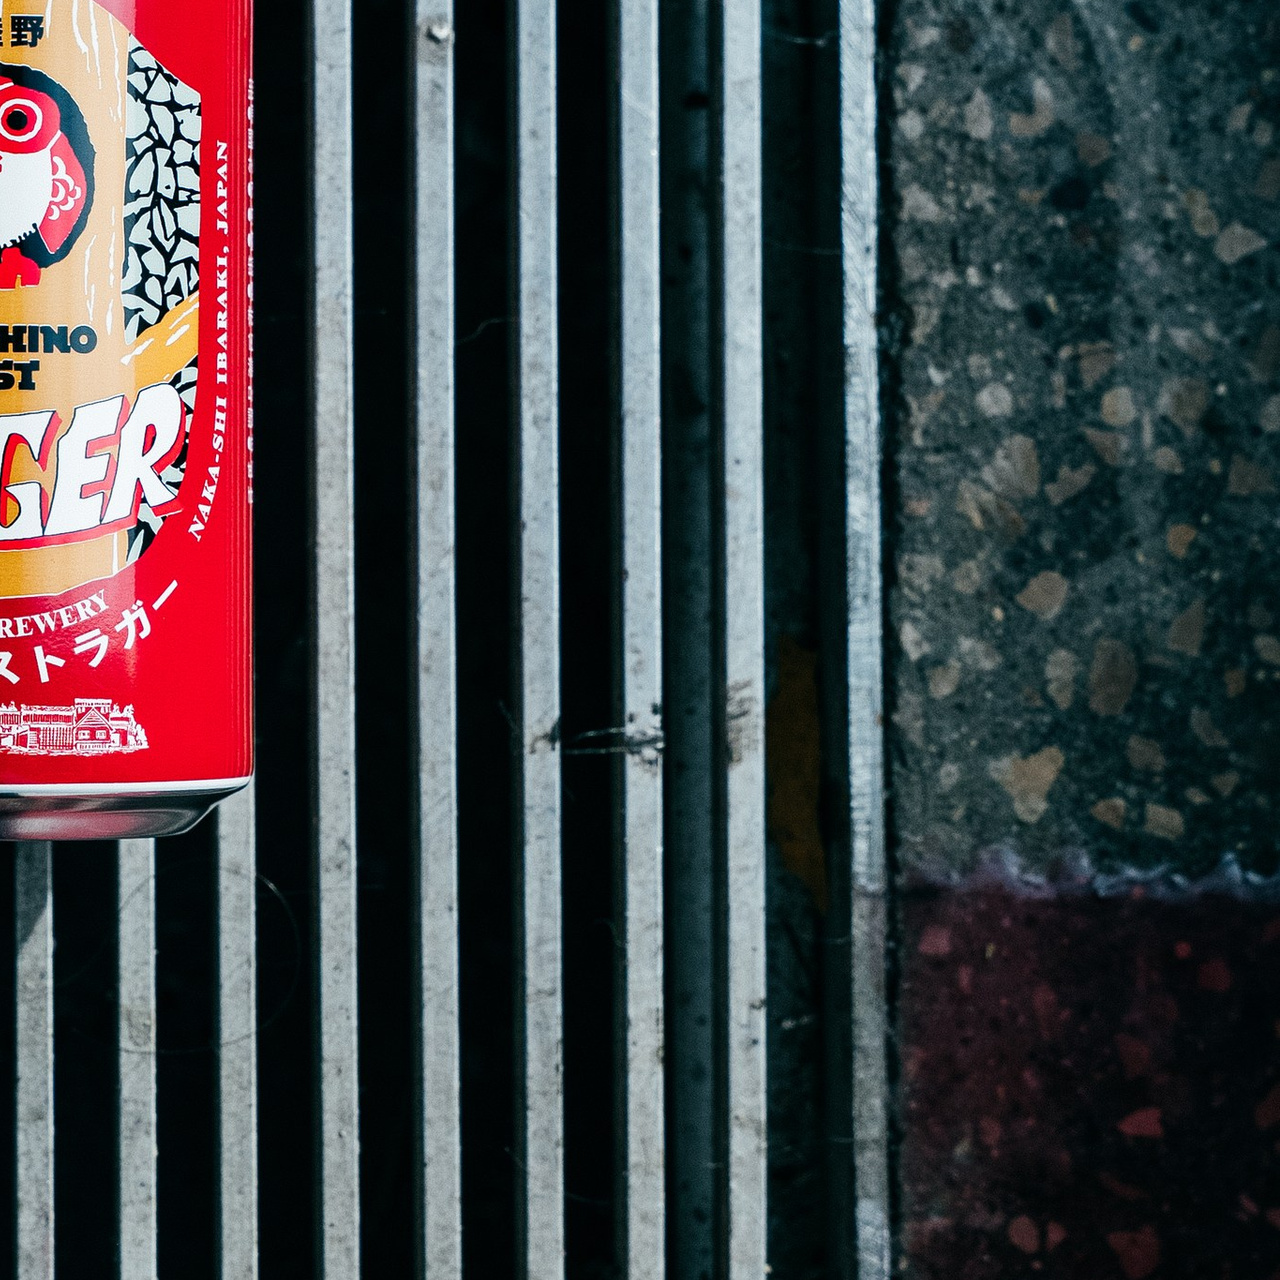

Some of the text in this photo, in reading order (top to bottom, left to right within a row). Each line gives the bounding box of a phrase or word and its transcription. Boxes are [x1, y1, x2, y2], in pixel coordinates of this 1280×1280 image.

[188, 140, 229, 543] NAKA-SHI IBARAKI, JAPAN
